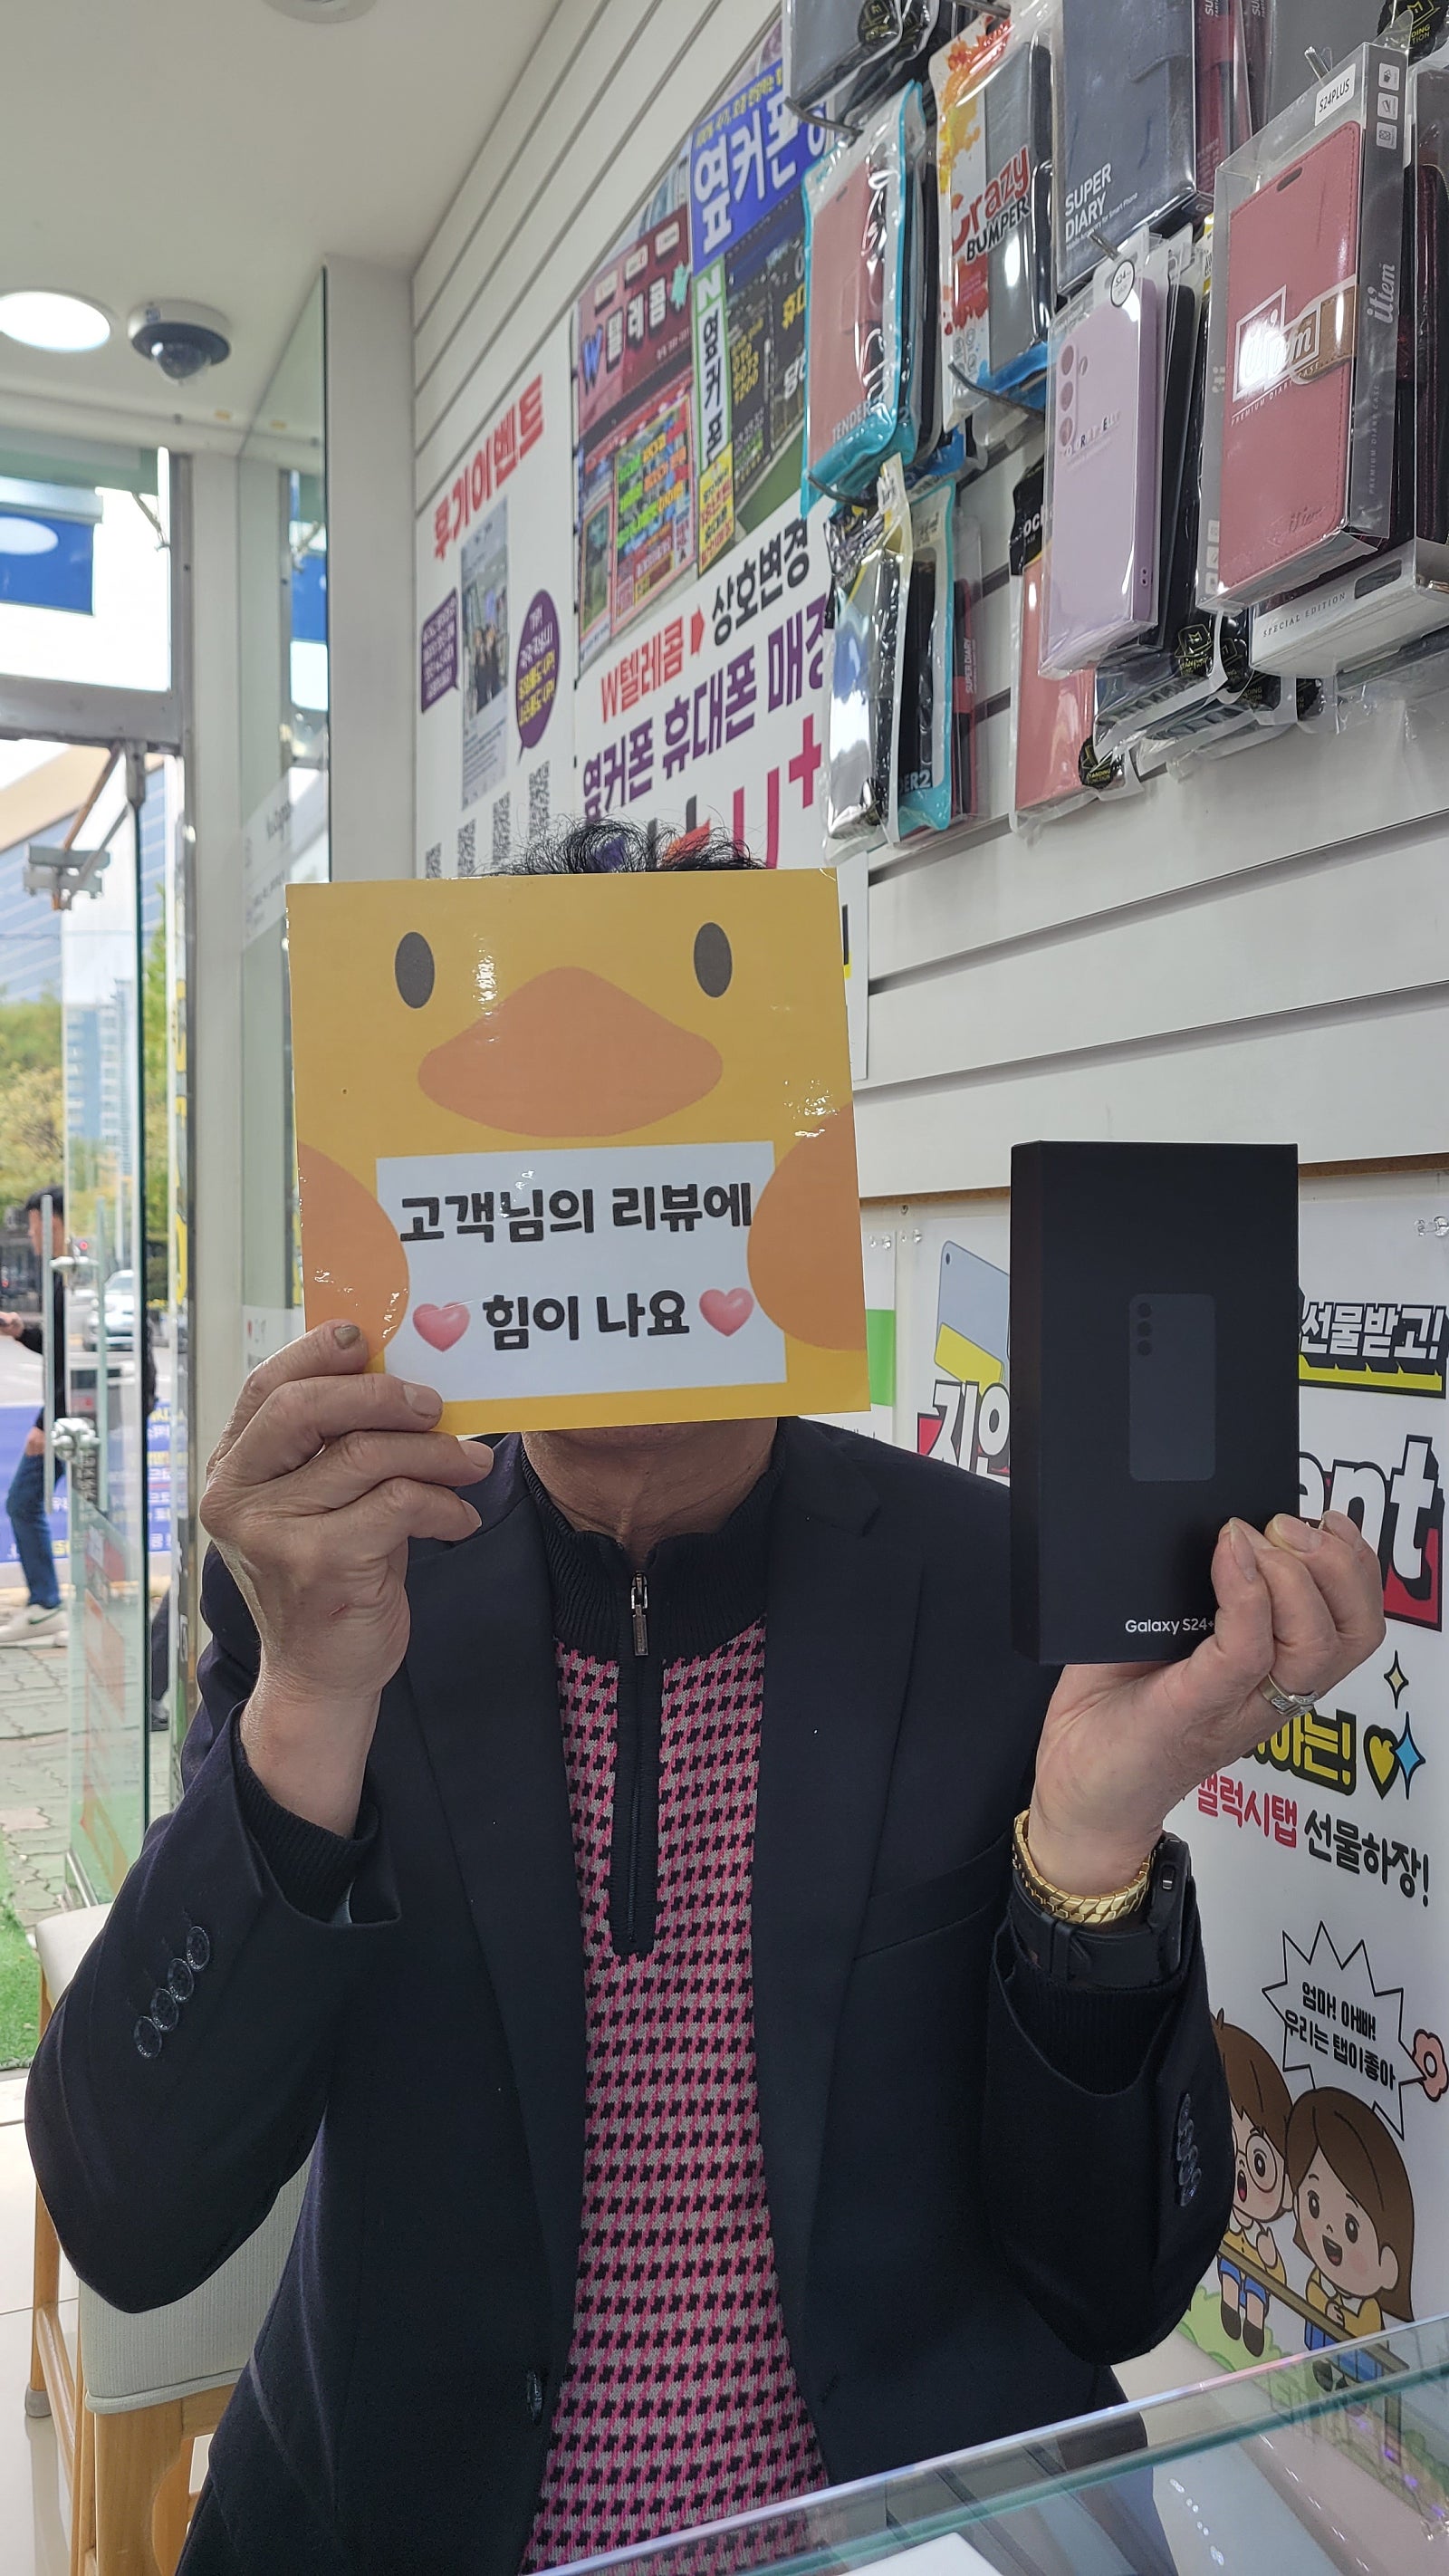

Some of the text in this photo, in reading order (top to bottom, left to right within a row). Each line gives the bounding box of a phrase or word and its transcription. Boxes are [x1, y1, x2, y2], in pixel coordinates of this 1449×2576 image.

[1319, 78, 1350, 114] S24PLUS
[695, 91, 799, 254] 옆커폰
[952, 146, 1031, 257] Crazy
[1065, 163, 1112, 217] SUPER
[965, 197, 1031, 262] BUMPER
[1065, 191, 1107, 244] DIARY
[1231, 399, 1265, 428] PREMIUM
[434, 373, 544, 561] 후기이벤트
[600, 616, 685, 723] W텔레콤
[711, 519, 809, 646] 상호변경
[1263, 591, 1346, 638] SPECIAL EDITION
[583, 718, 655, 820] 옆커폰
[663, 645, 757, 781] 휴대폰
[399, 1182, 753, 1243] 고객님의 리뷰에
[482, 1289, 690, 1350] 힘이 나요
[1300, 1300, 1446, 1360] 선물받고!
[1125, 1617, 1214, 1636] Galaxy S24+
[1197, 1773, 1429, 1908] 갤럭시탭 선물하장!
[1301, 1981, 1377, 2042] 엄마! 아빠!
[1285, 2009, 1396, 2091] 우리는 탭이좋아
